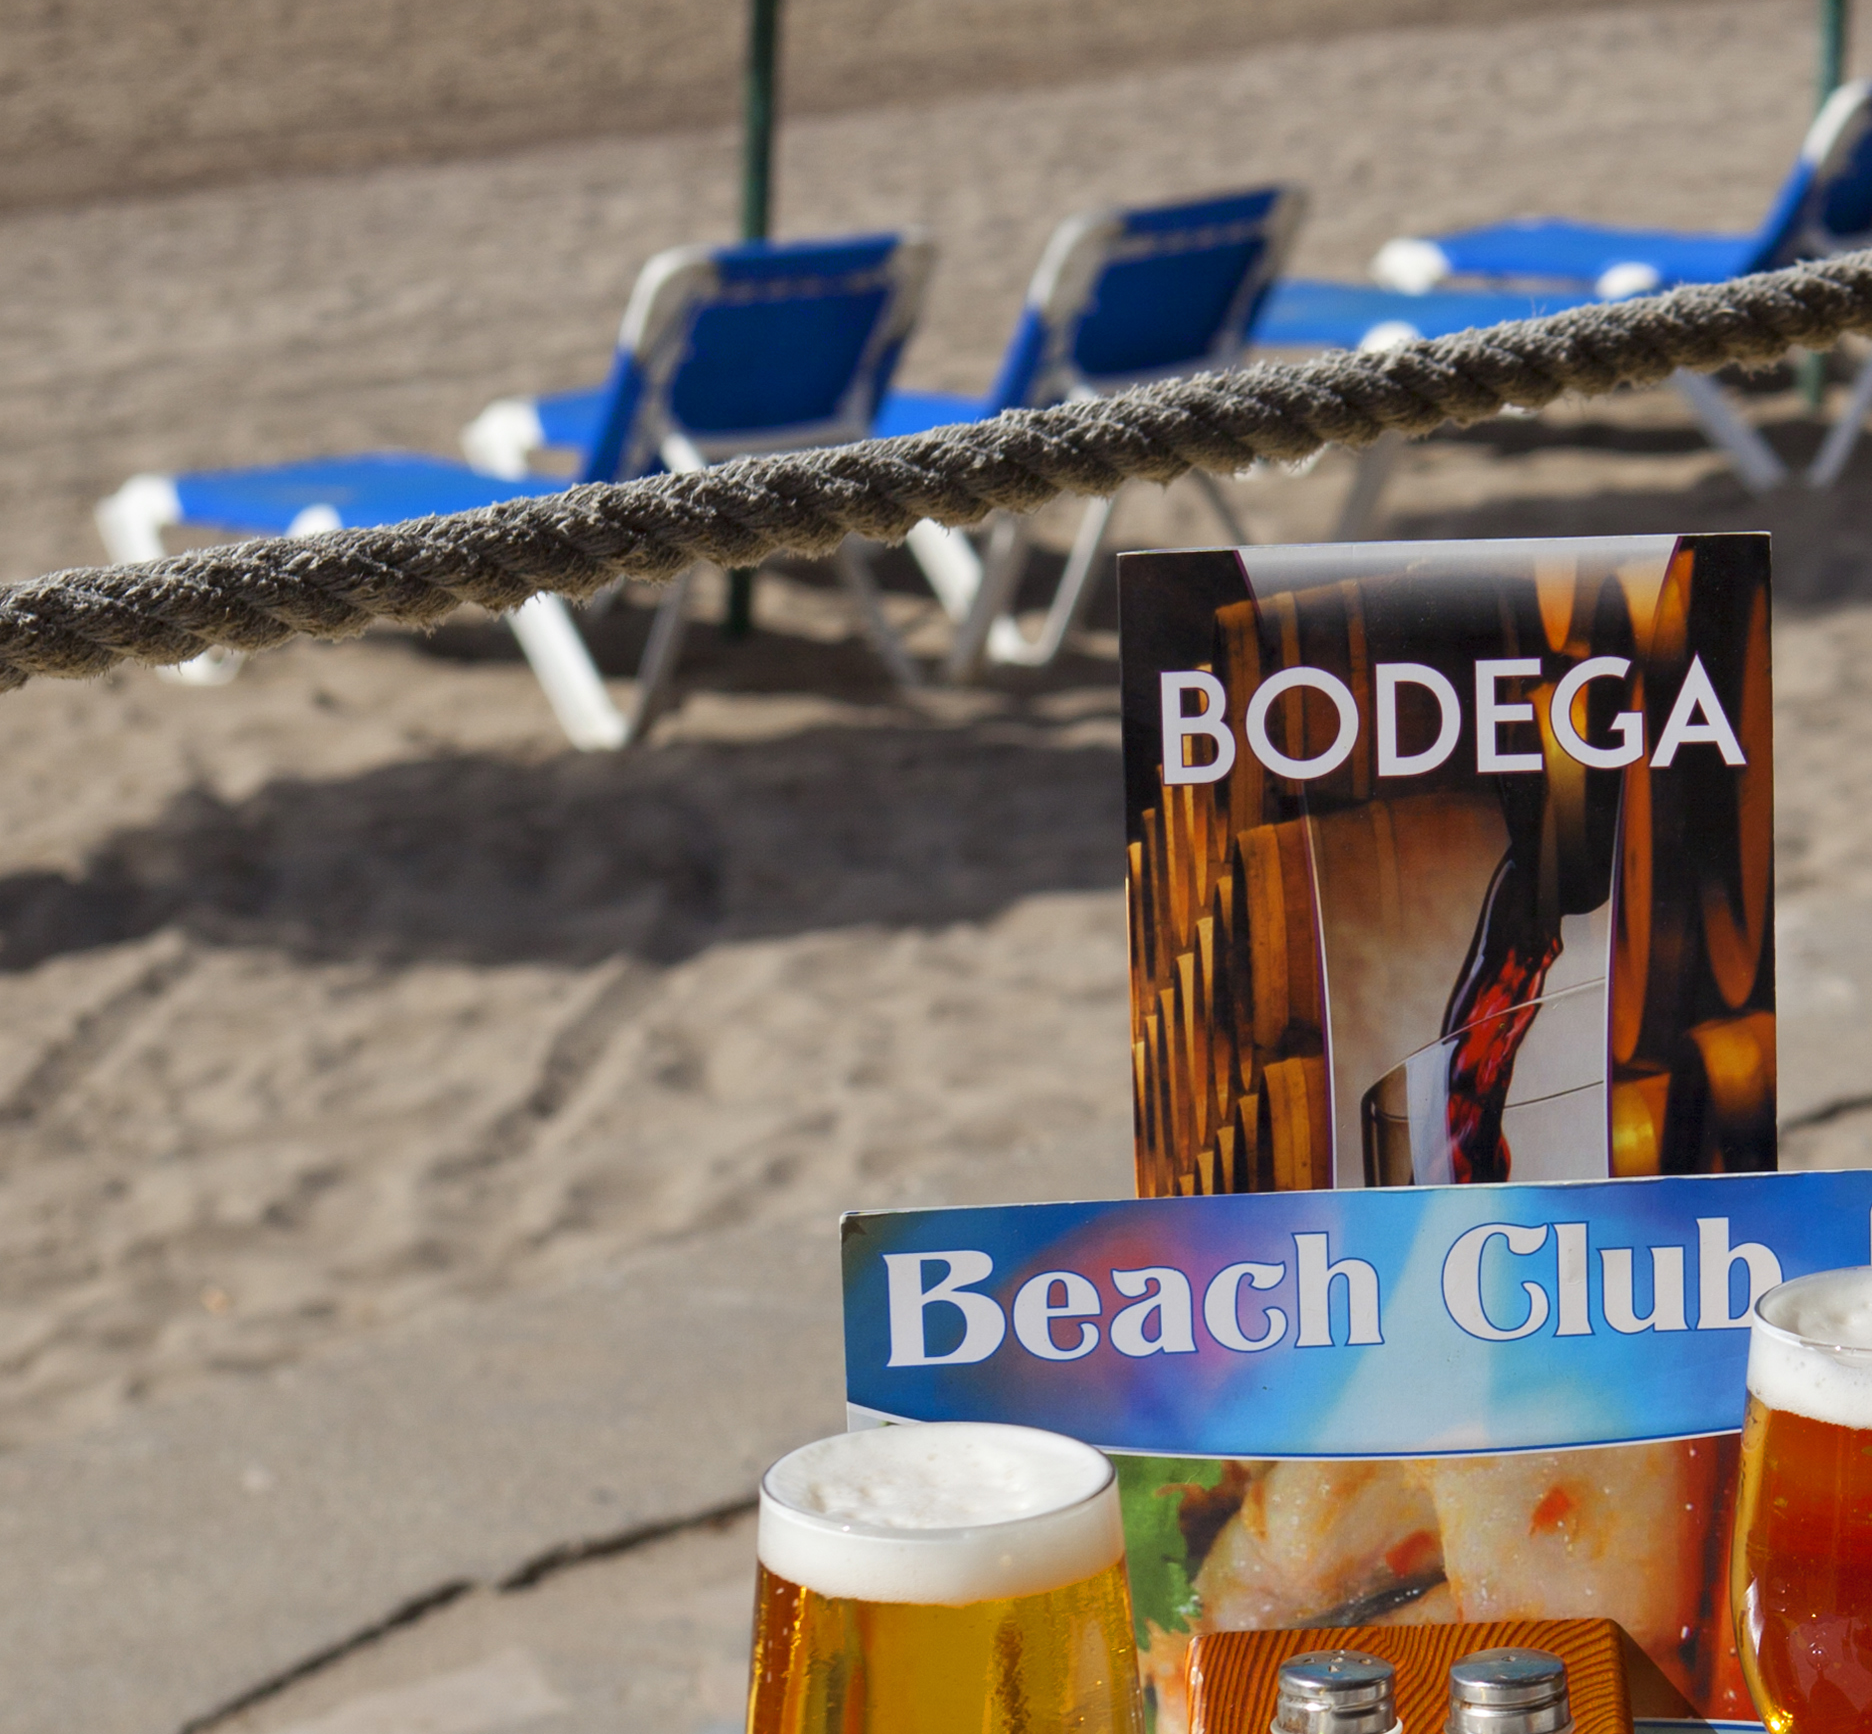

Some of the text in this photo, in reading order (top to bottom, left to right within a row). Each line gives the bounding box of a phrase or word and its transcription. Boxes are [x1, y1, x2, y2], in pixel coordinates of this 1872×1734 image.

[1159, 651, 1748, 786] BODEGA
[881, 1216, 1784, 1368] Beach Club
